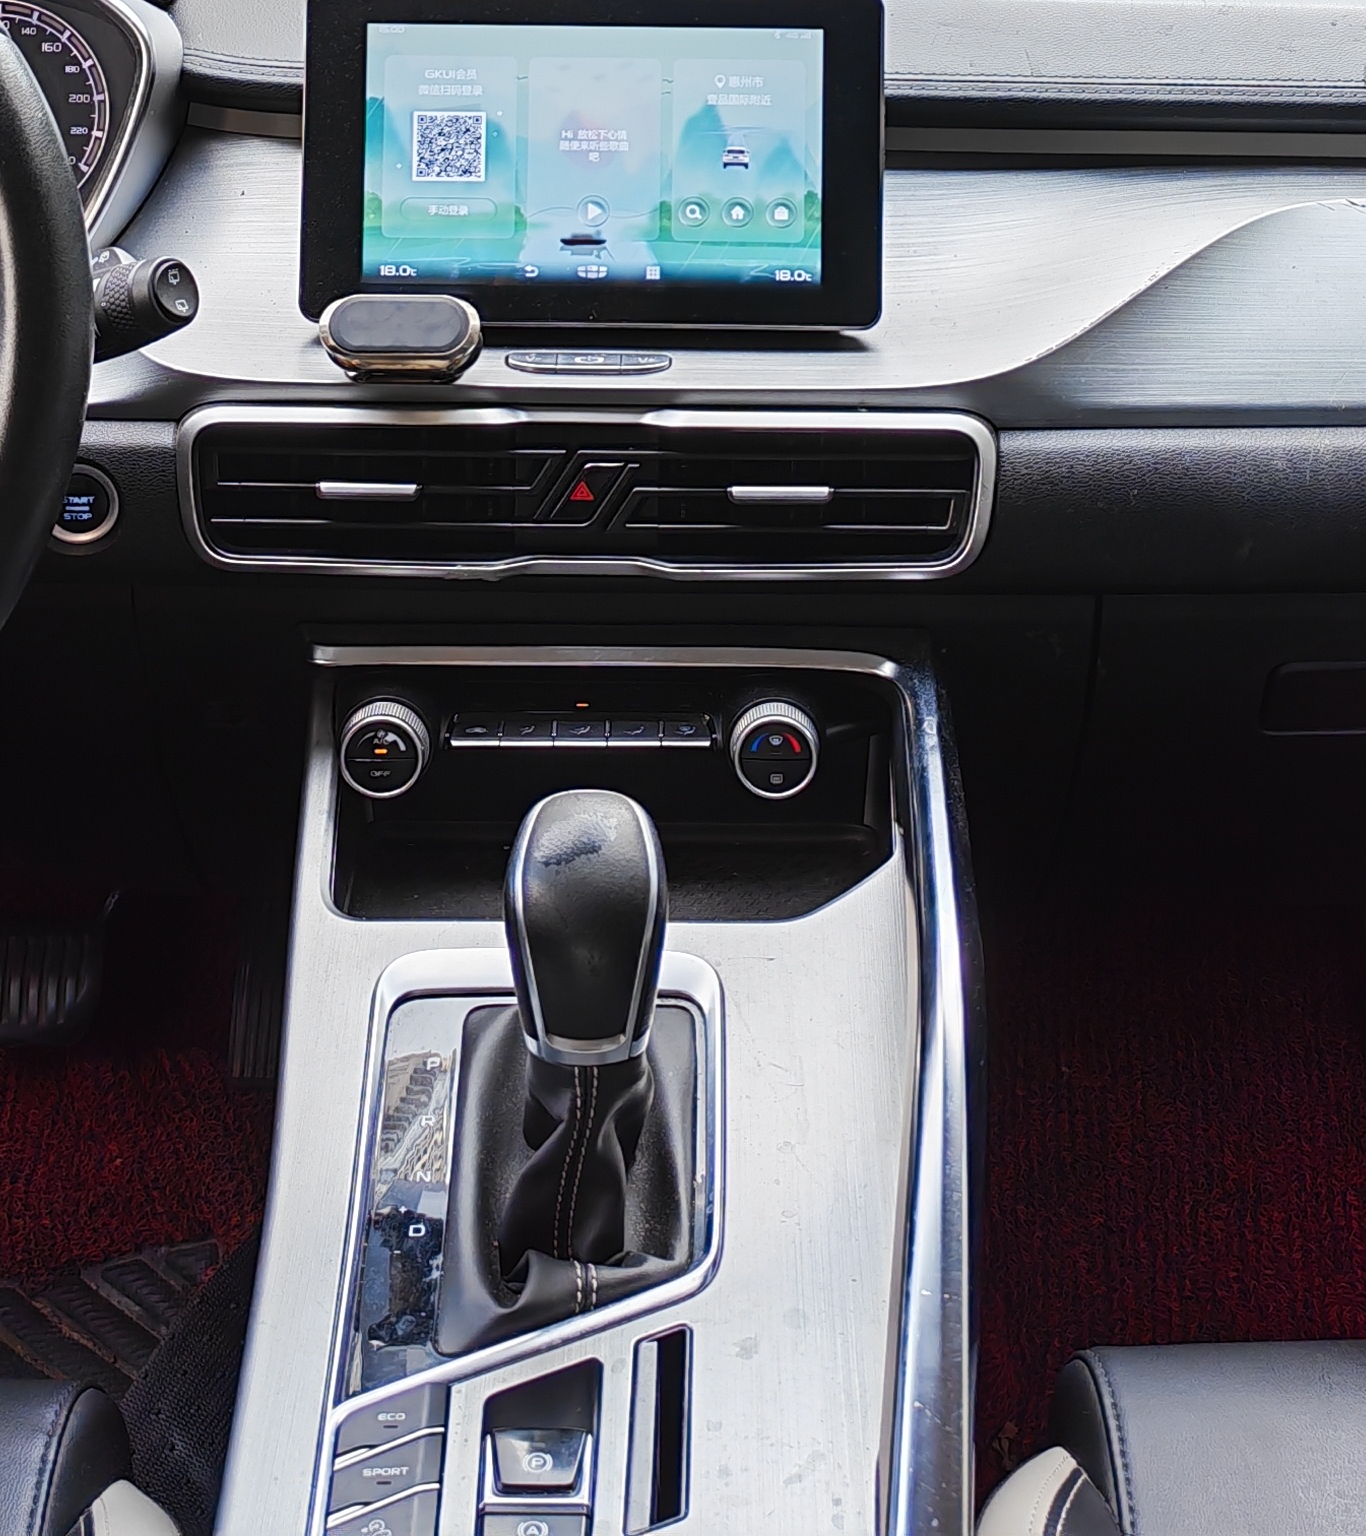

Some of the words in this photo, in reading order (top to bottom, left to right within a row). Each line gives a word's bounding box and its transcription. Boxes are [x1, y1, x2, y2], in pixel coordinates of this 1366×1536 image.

[21, 27, 37, 35] 140
[41, 42, 62, 53] 160
[424, 69, 477, 80] GKUI会员
[728, 75, 764, 88] 惠州市
[418, 85, 483, 96] 微信扫码登录
[68, 94, 91, 103] 200
[70, 127, 89, 135] 220
[561, 129, 574, 139] Hi
[577, 129, 627, 140] 放松下心情
[559, 140, 629, 151] 随便来听些歌曲
[588, 151, 600, 162] 吧
[428, 204, 469, 216] 手动登录
[63, 512, 93, 520] STOP
[426, 1057, 441, 1071] P
[421, 1115, 435, 1127] R
[416, 1171, 432, 1182] N
[408, 1224, 426, 1237] D
[377, 1412, 406, 1421] ECO
[362, 1466, 409, 1477] SPORT
